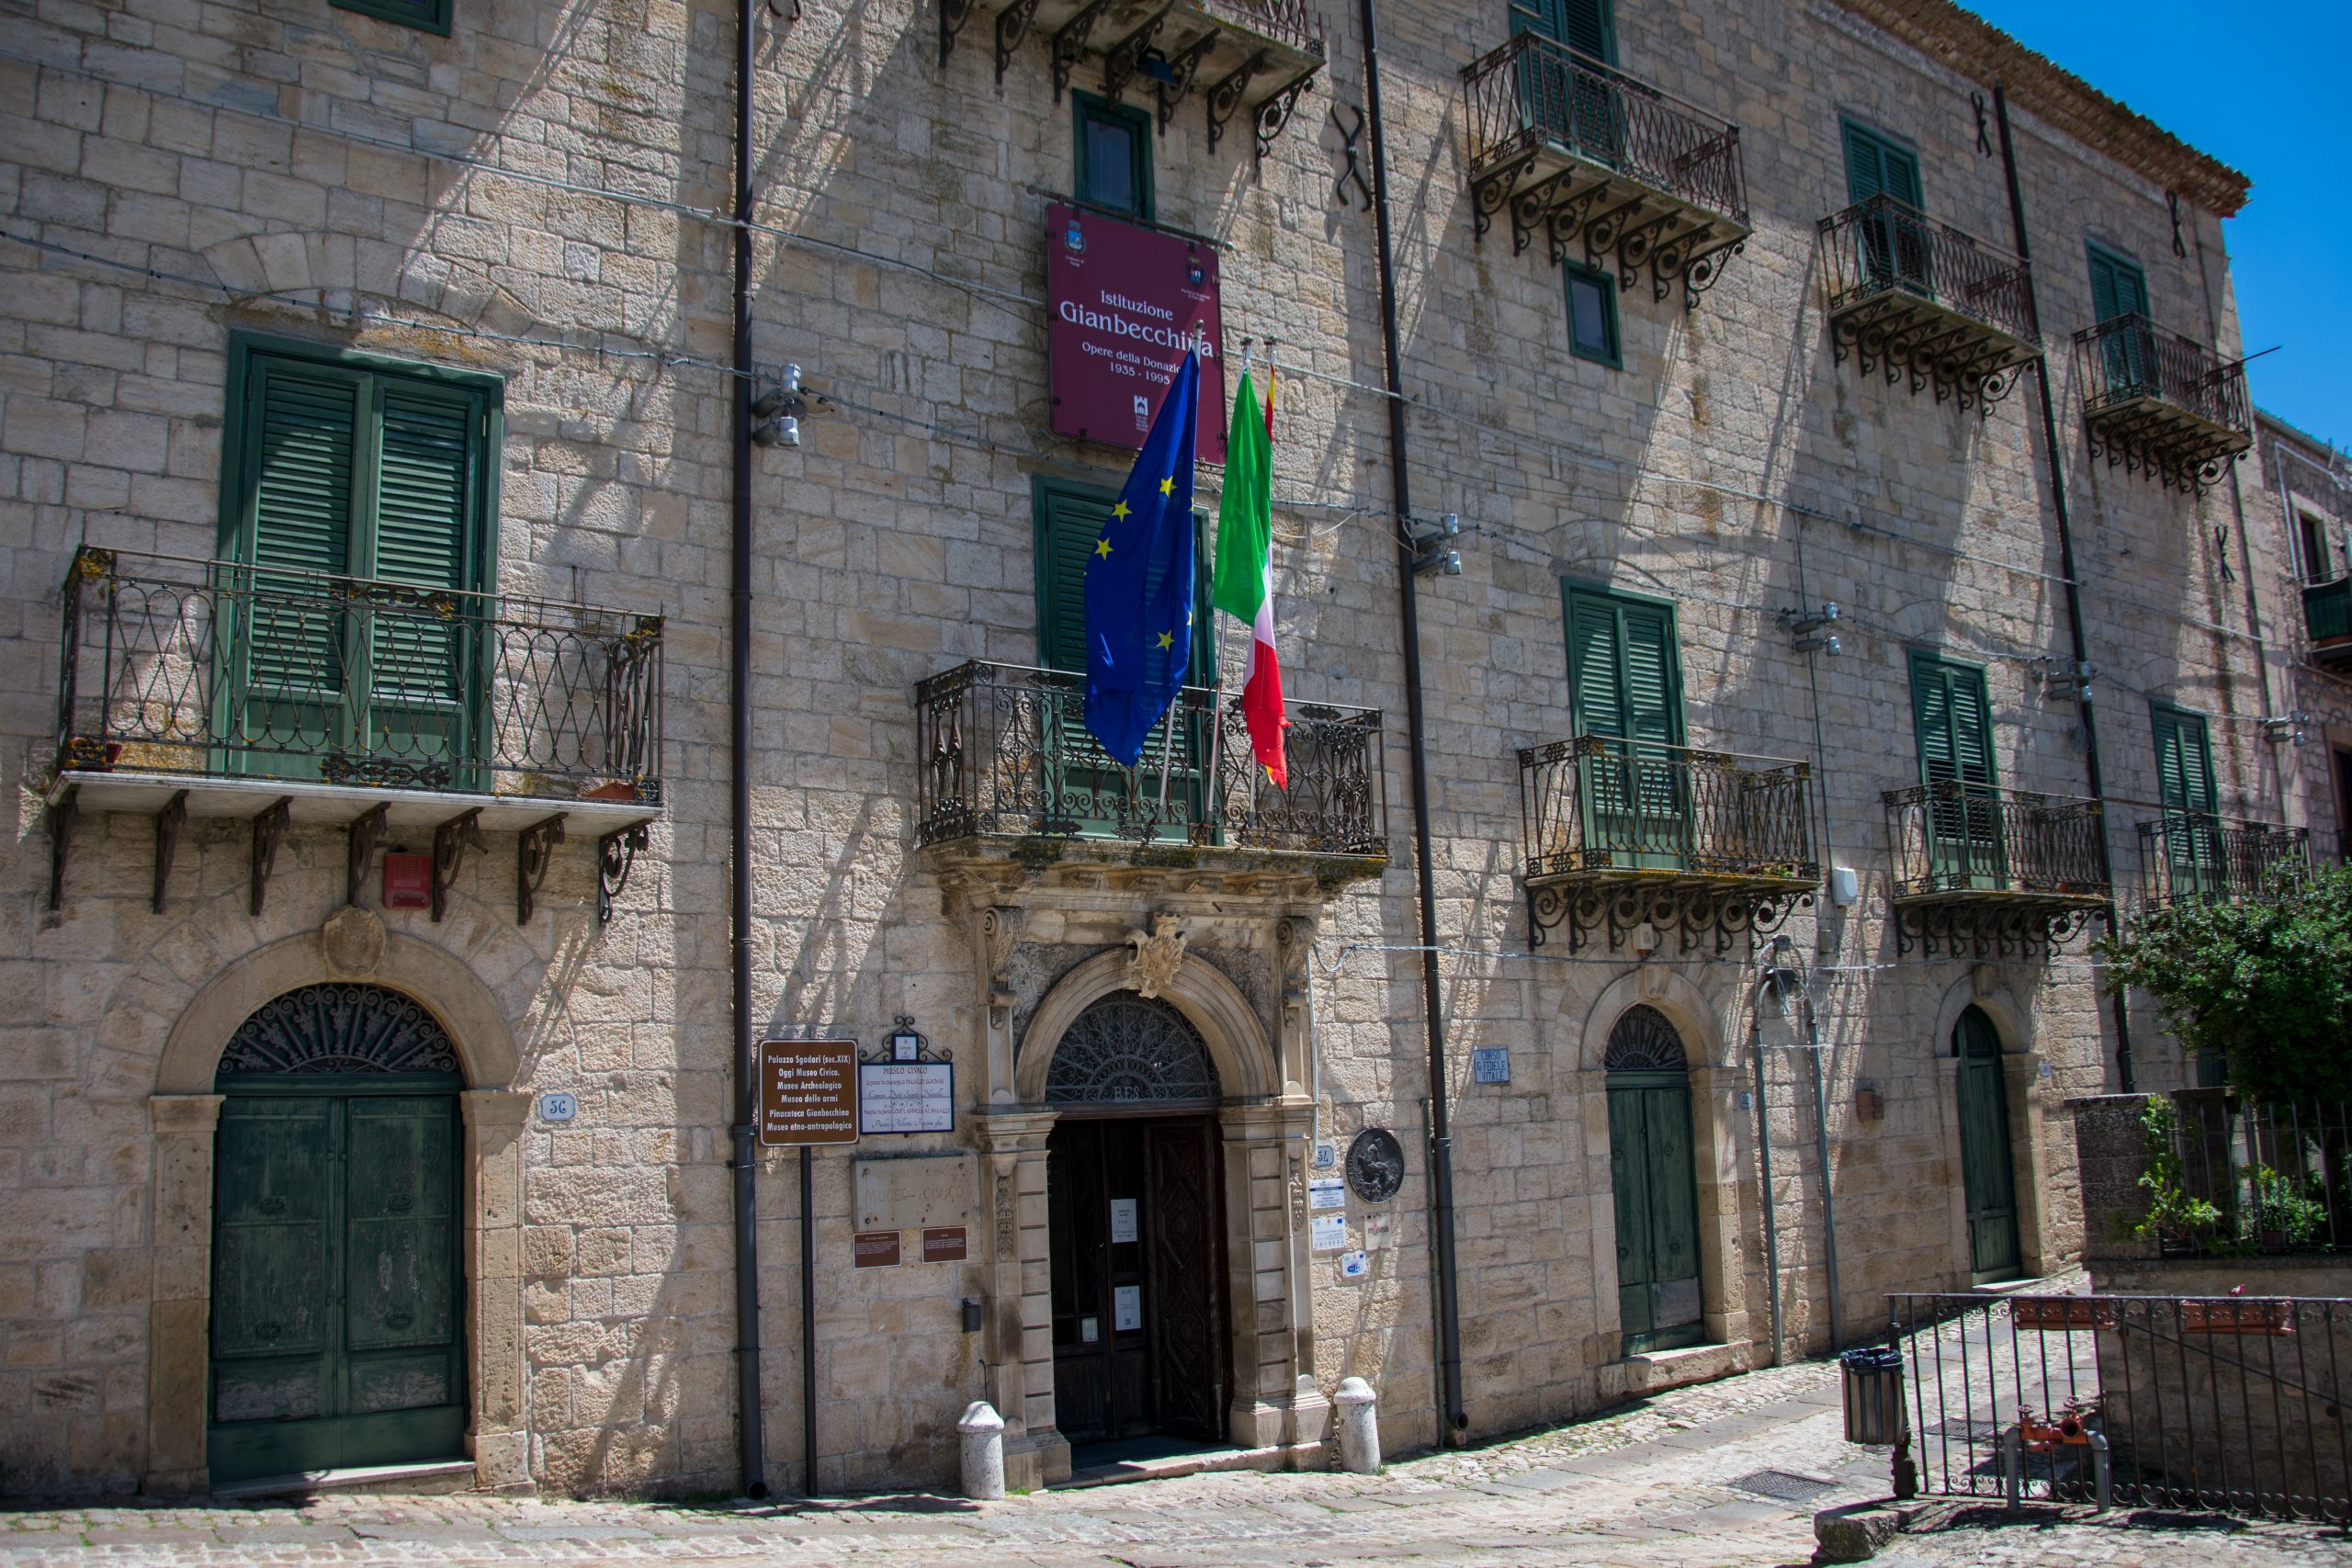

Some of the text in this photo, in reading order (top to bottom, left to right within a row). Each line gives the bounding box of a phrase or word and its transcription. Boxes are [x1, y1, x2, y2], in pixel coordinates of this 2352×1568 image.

[1101, 290, 1173, 321] Istituzione
[1082, 341, 1114, 359] Opere
[1116, 350, 1140, 365] della
[1110, 362, 1136, 377] 1935
[1146, 370, 1170, 385] 1995
[767, 1055, 851, 1066] Palazzo Sgadari (sec.XIX)
[1481, 1050, 1500, 1060] CORSO
[778, 1067, 840, 1078] Oggi Museo Civico.
[883, 1066, 928, 1075] MUSEO CIVICO
[1482, 1071, 1504, 1081] VITALE
[777, 1080, 842, 1091] Museo Archeologico
[781, 1094, 838, 1103] Museo delle armi
[769, 1108, 850, 1118] Pinacoteca Gianbecchina
[767, 1121, 853, 1132] Museo etno-antropologico
